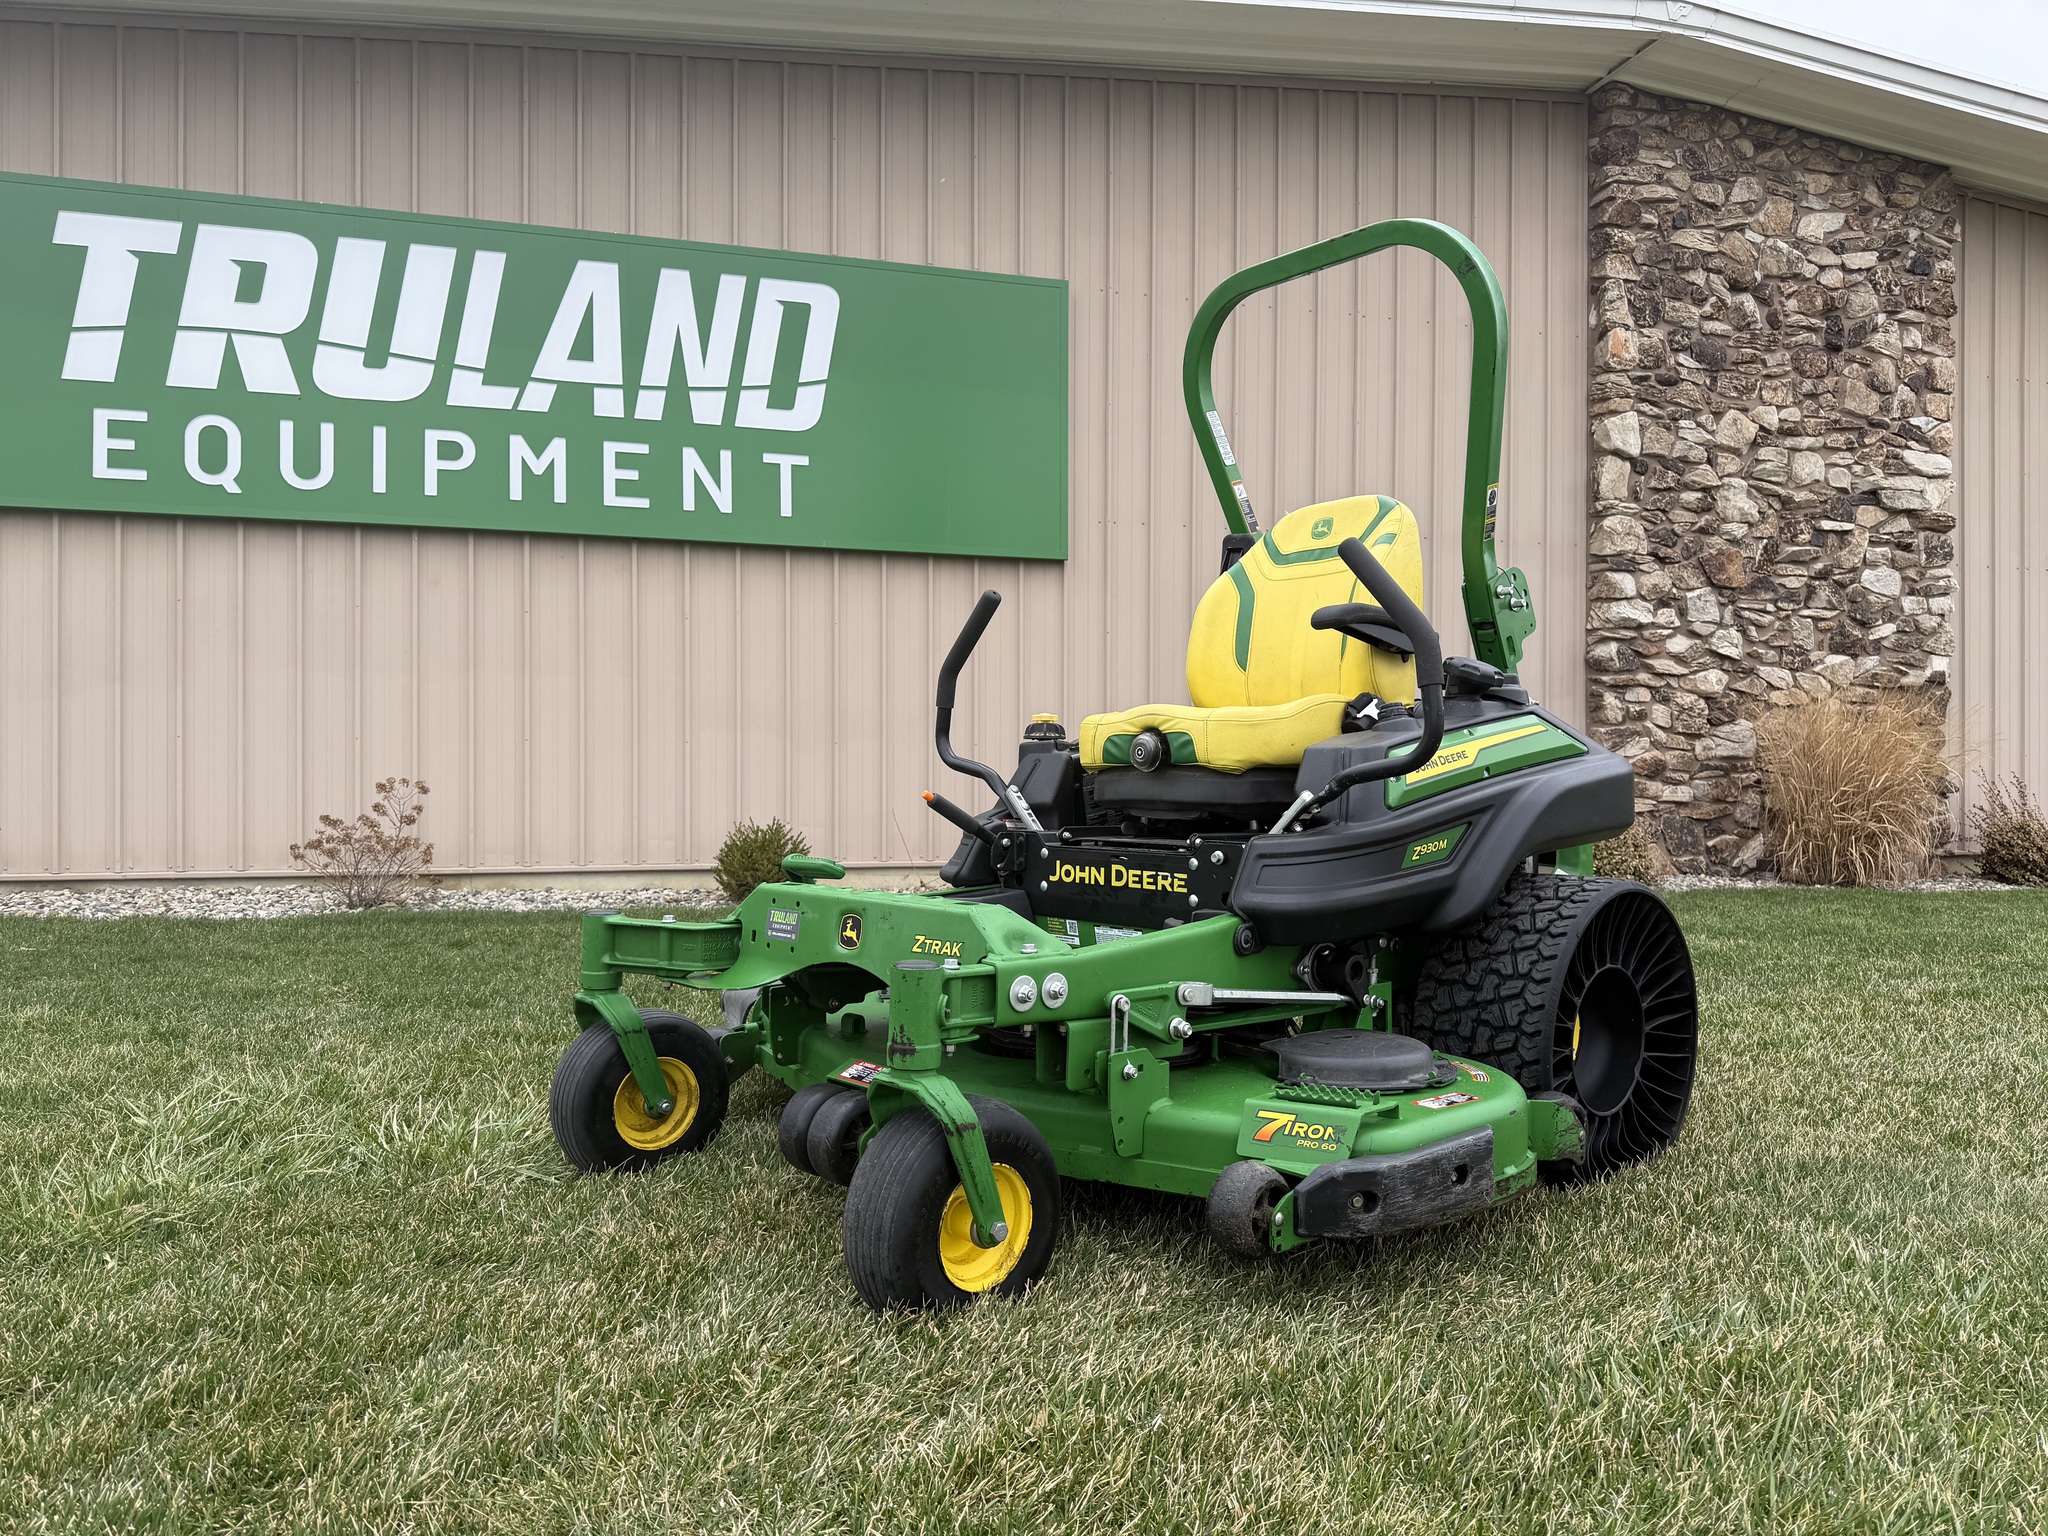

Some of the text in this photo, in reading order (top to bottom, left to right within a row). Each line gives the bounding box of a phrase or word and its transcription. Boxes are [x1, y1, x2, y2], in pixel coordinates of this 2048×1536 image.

[53, 210, 840, 432] TRULAND
[92, 408, 810, 518] EQUIPMENT
[1438, 750, 1468, 765] DEERE
[1411, 838, 1448, 861] Z930M
[1049, 860, 1188, 893] JOHN DEERE
[770, 910, 797, 924] TRULAND
[911, 935, 963, 957] ZTRAK
[1297, 1140, 1337, 1151] PRO 60
